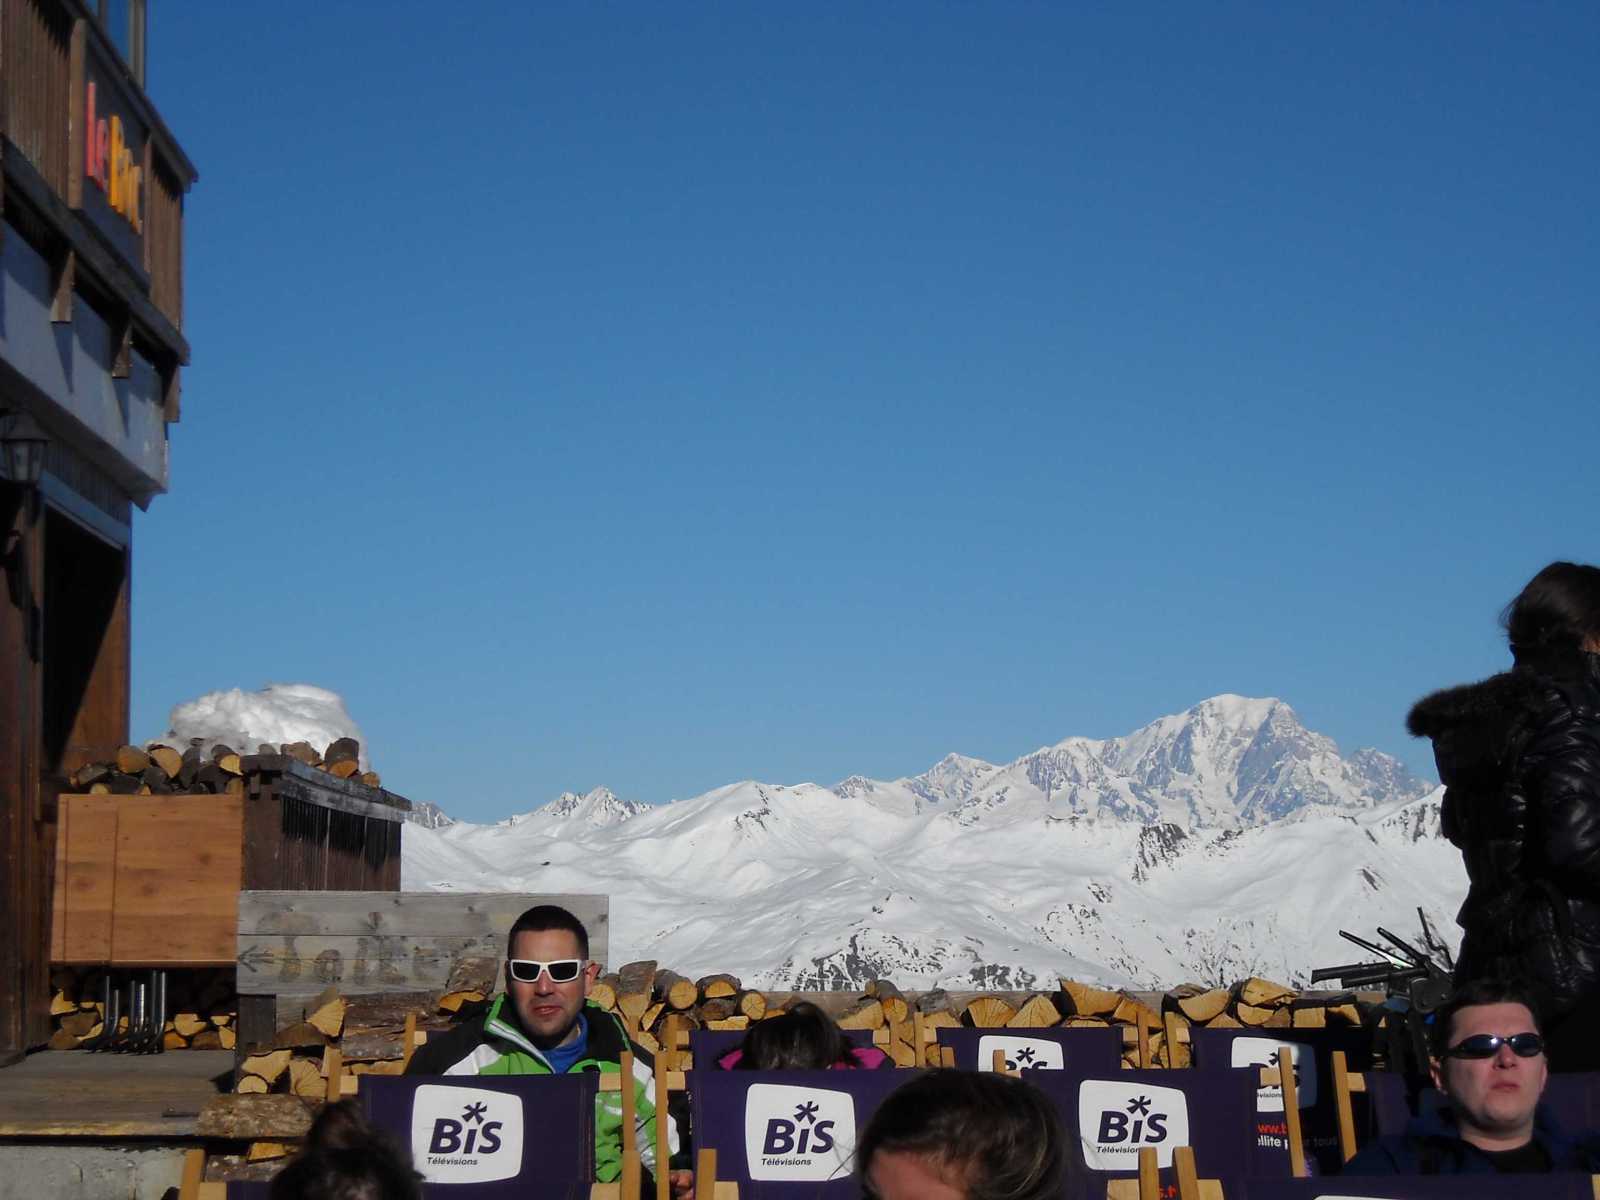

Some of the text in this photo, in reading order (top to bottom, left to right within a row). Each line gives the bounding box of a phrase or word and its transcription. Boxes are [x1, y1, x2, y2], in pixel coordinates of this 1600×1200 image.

[1096, 1145, 1140, 1154] Télévision
[427, 1156, 479, 1166] Télévisions
[761, 1157, 813, 1167] Télévisions
